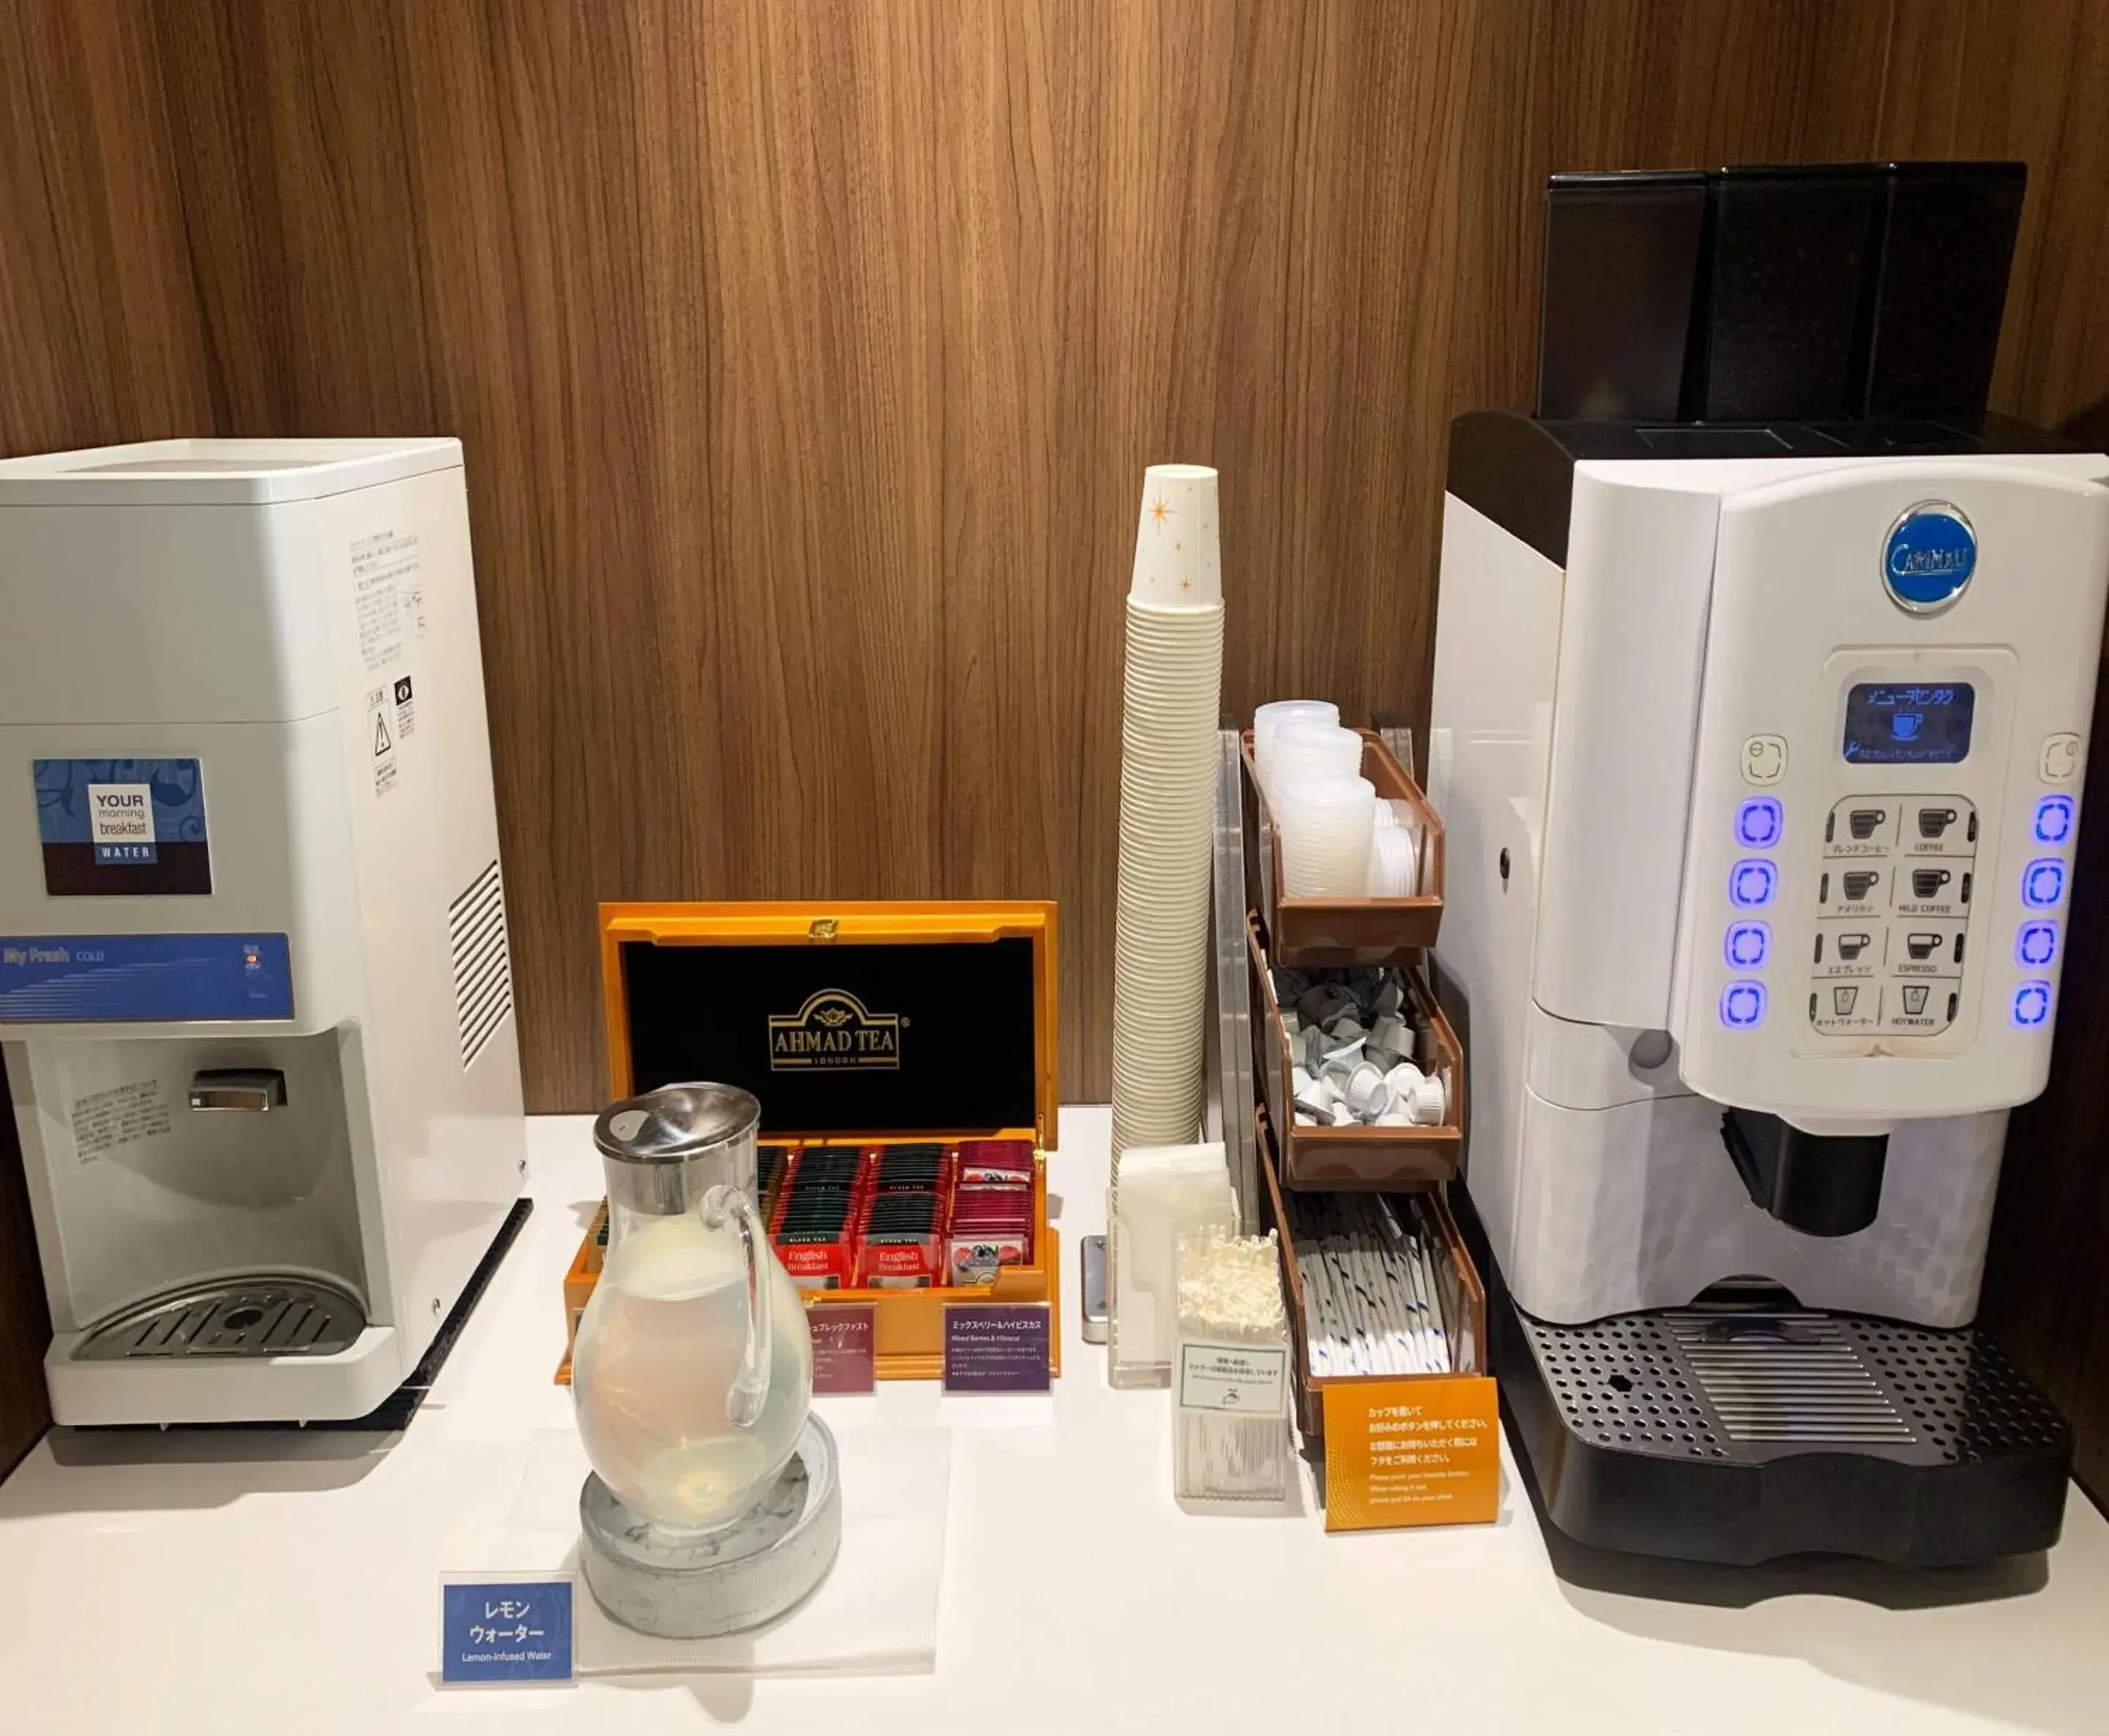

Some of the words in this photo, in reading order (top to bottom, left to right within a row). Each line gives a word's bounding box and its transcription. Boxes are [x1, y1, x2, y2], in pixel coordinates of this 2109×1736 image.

[97, 794, 144, 808] YOUR
[99, 809, 145, 819] morning
[100, 822, 147, 835] breakfast
[102, 847, 149, 857] WATER
[1914, 843, 1944, 852] COFFEE
[1837, 905, 1874, 913] アメリカン
[1921, 905, 1951, 913] COFFEE
[76, 950, 105, 962] COLD
[1898, 964, 1937, 973] ESPRESSO
[775, 1031, 852, 1053] AHMAD
[855, 1029, 895, 1051] TEA
[814, 1056, 857, 1065] LONDON
[789, 1251, 827, 1262] English
[879, 1251, 918, 1262] English
[485, 1601, 530, 1619] レモン
[469, 1623, 545, 1644] ウォーター
[527, 1650, 552, 1661] Water
